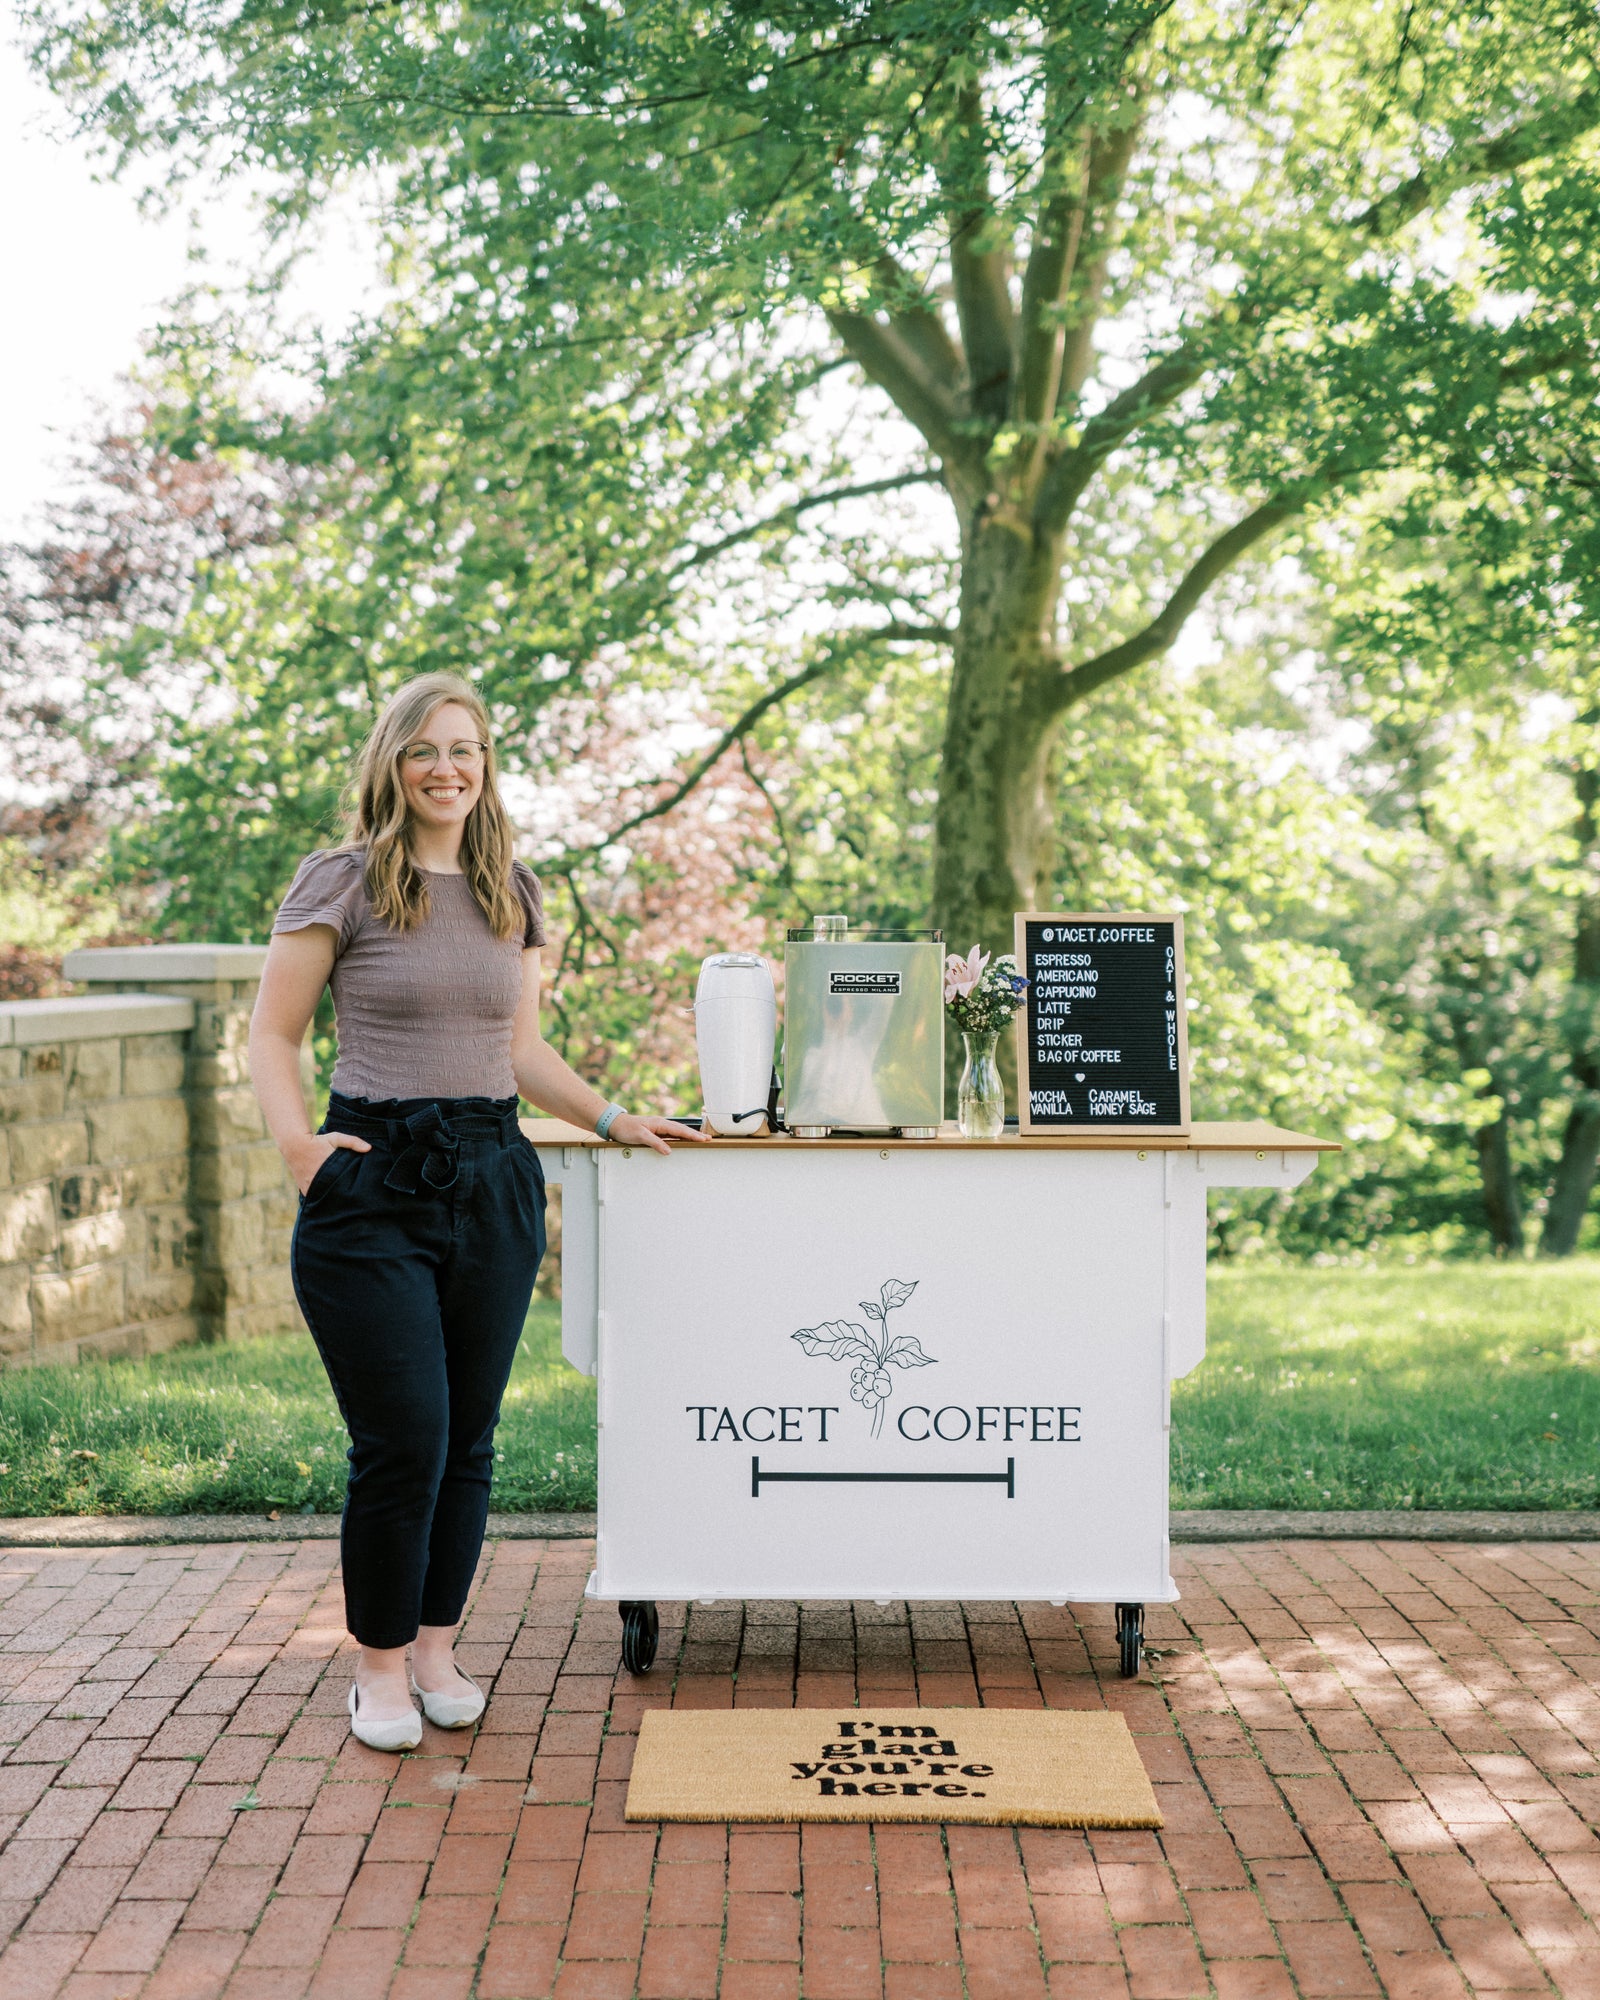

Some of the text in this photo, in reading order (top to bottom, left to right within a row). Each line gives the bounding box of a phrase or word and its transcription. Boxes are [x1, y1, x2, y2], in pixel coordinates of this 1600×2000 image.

[1042, 928, 1155, 943] @TACET.COFFEE
[1035, 954, 1091, 966] ESPRESSO
[1036, 970, 1099, 982] AMERICANO
[1036, 986, 1096, 998] CAPPUCINO
[1038, 1002, 1071, 1014] LATTE
[1037, 1018, 1065, 1030] DRIP
[1037, 1034, 1082, 1046] STICKER
[1038, 1051, 1121, 1062] BAG OF COFFEE
[1029, 1090, 1066, 1103] MOCHA
[1089, 1089, 1144, 1103] CARAMEL
[1031, 1103, 1073, 1115] VANILLA
[1090, 1103, 1156, 1115] HONEY SAGE
[686, 1406, 1081, 1442] TACET COFFEE
[837, 1721, 938, 1737] I'm
[822, 1739, 959, 1759] glad
[790, 1759, 994, 1779] you're
[817, 1777, 986, 1797] here.
